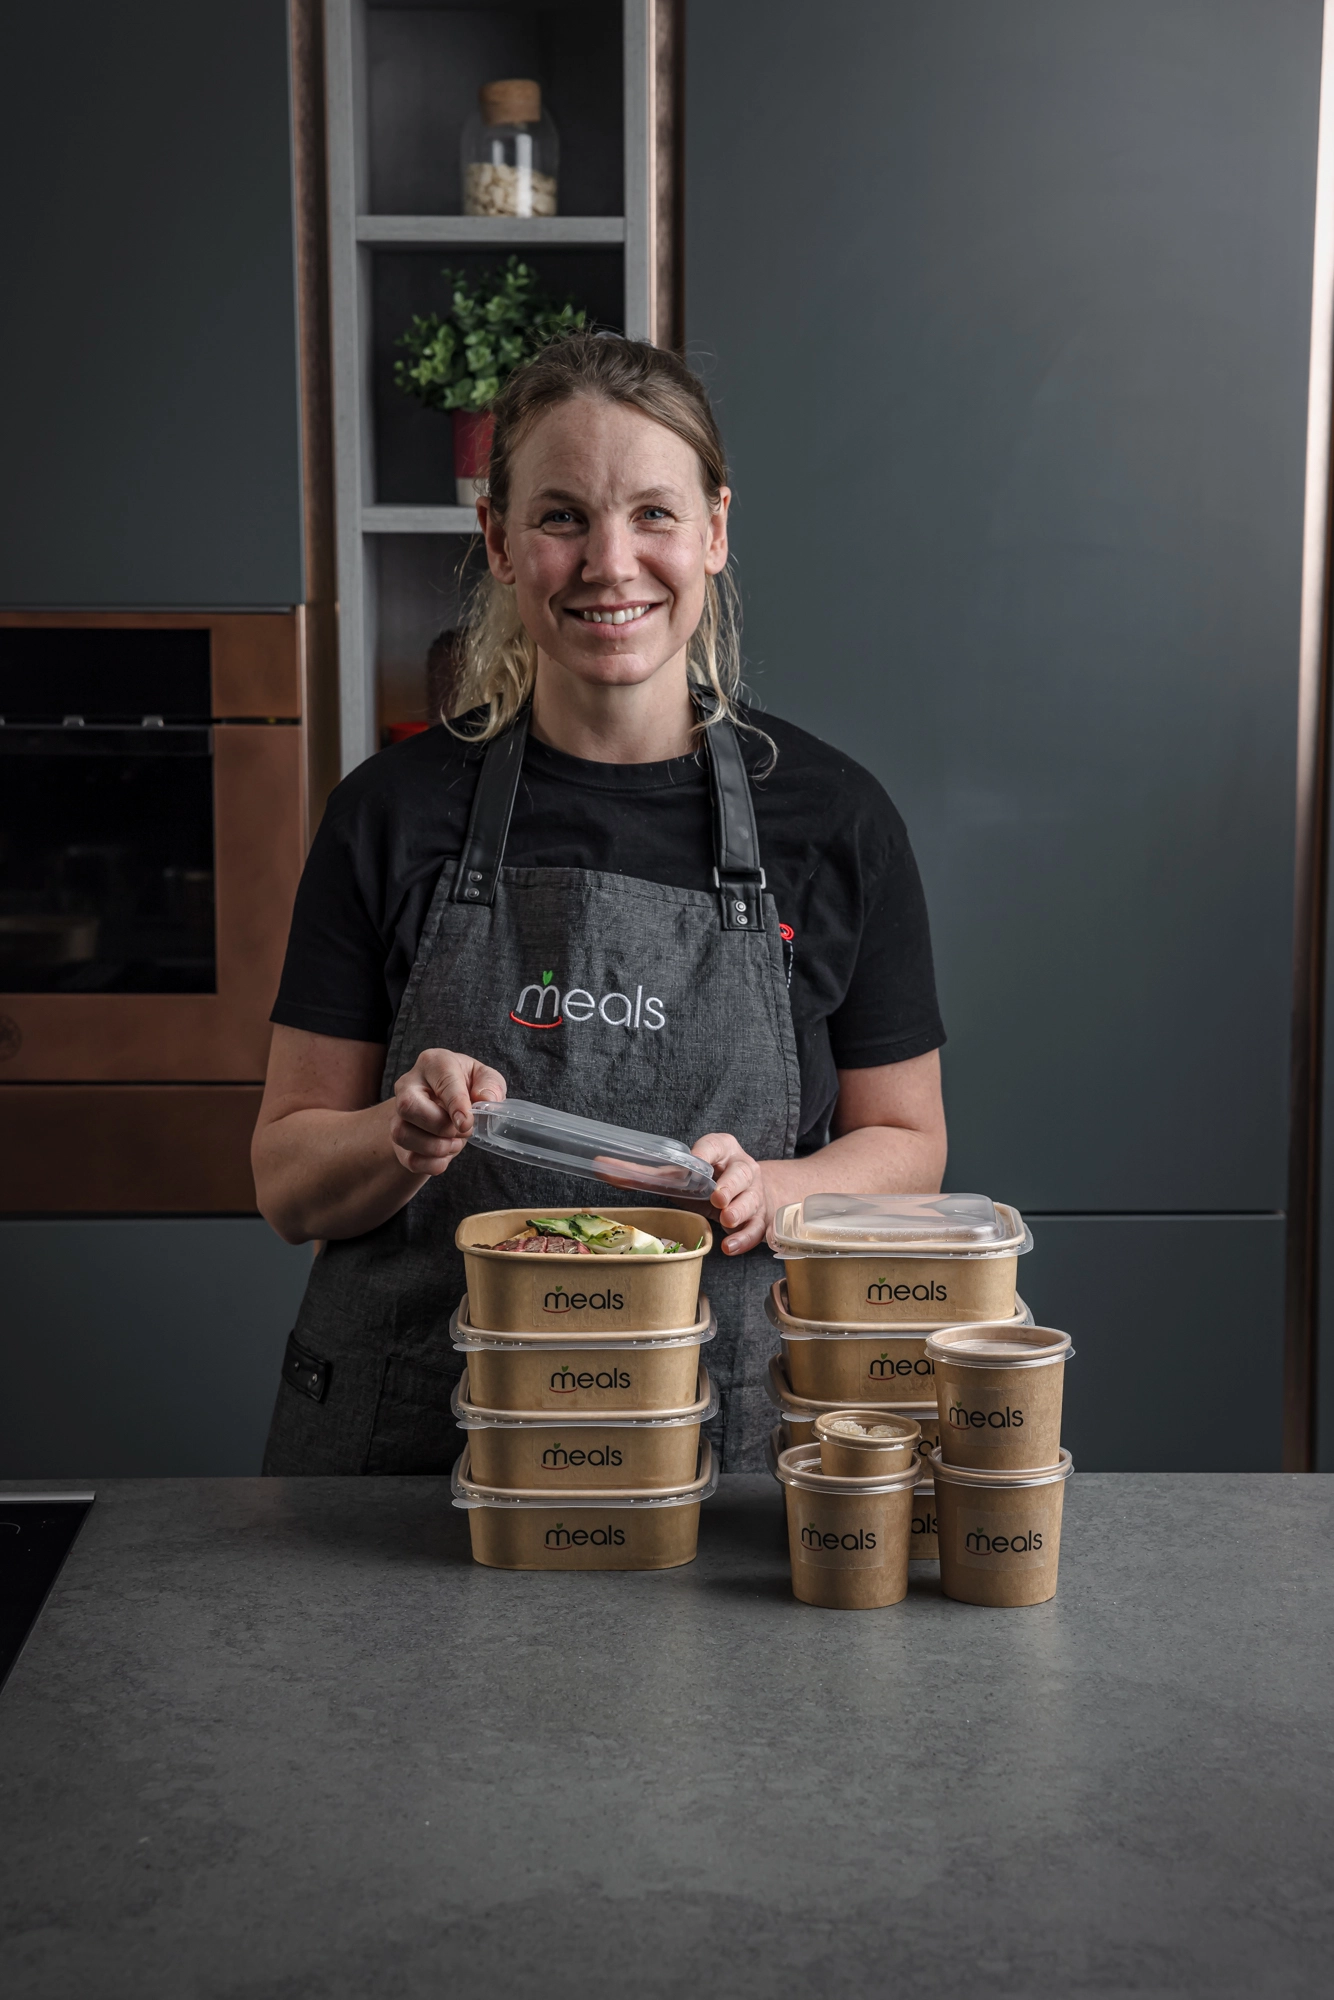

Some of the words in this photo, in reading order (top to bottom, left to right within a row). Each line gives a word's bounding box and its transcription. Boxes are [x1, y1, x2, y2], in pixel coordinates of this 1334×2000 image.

[516, 984, 666, 1031] meals
[544, 1288, 624, 1310] meals
[867, 1280, 948, 1302] meals
[551, 1367, 631, 1389] meals
[870, 1359, 936, 1377] meal
[949, 1406, 1024, 1429] meals
[542, 1445, 623, 1467] meals
[546, 1524, 626, 1546] meals
[801, 1527, 877, 1551] meals
[966, 1530, 1043, 1554] meals
